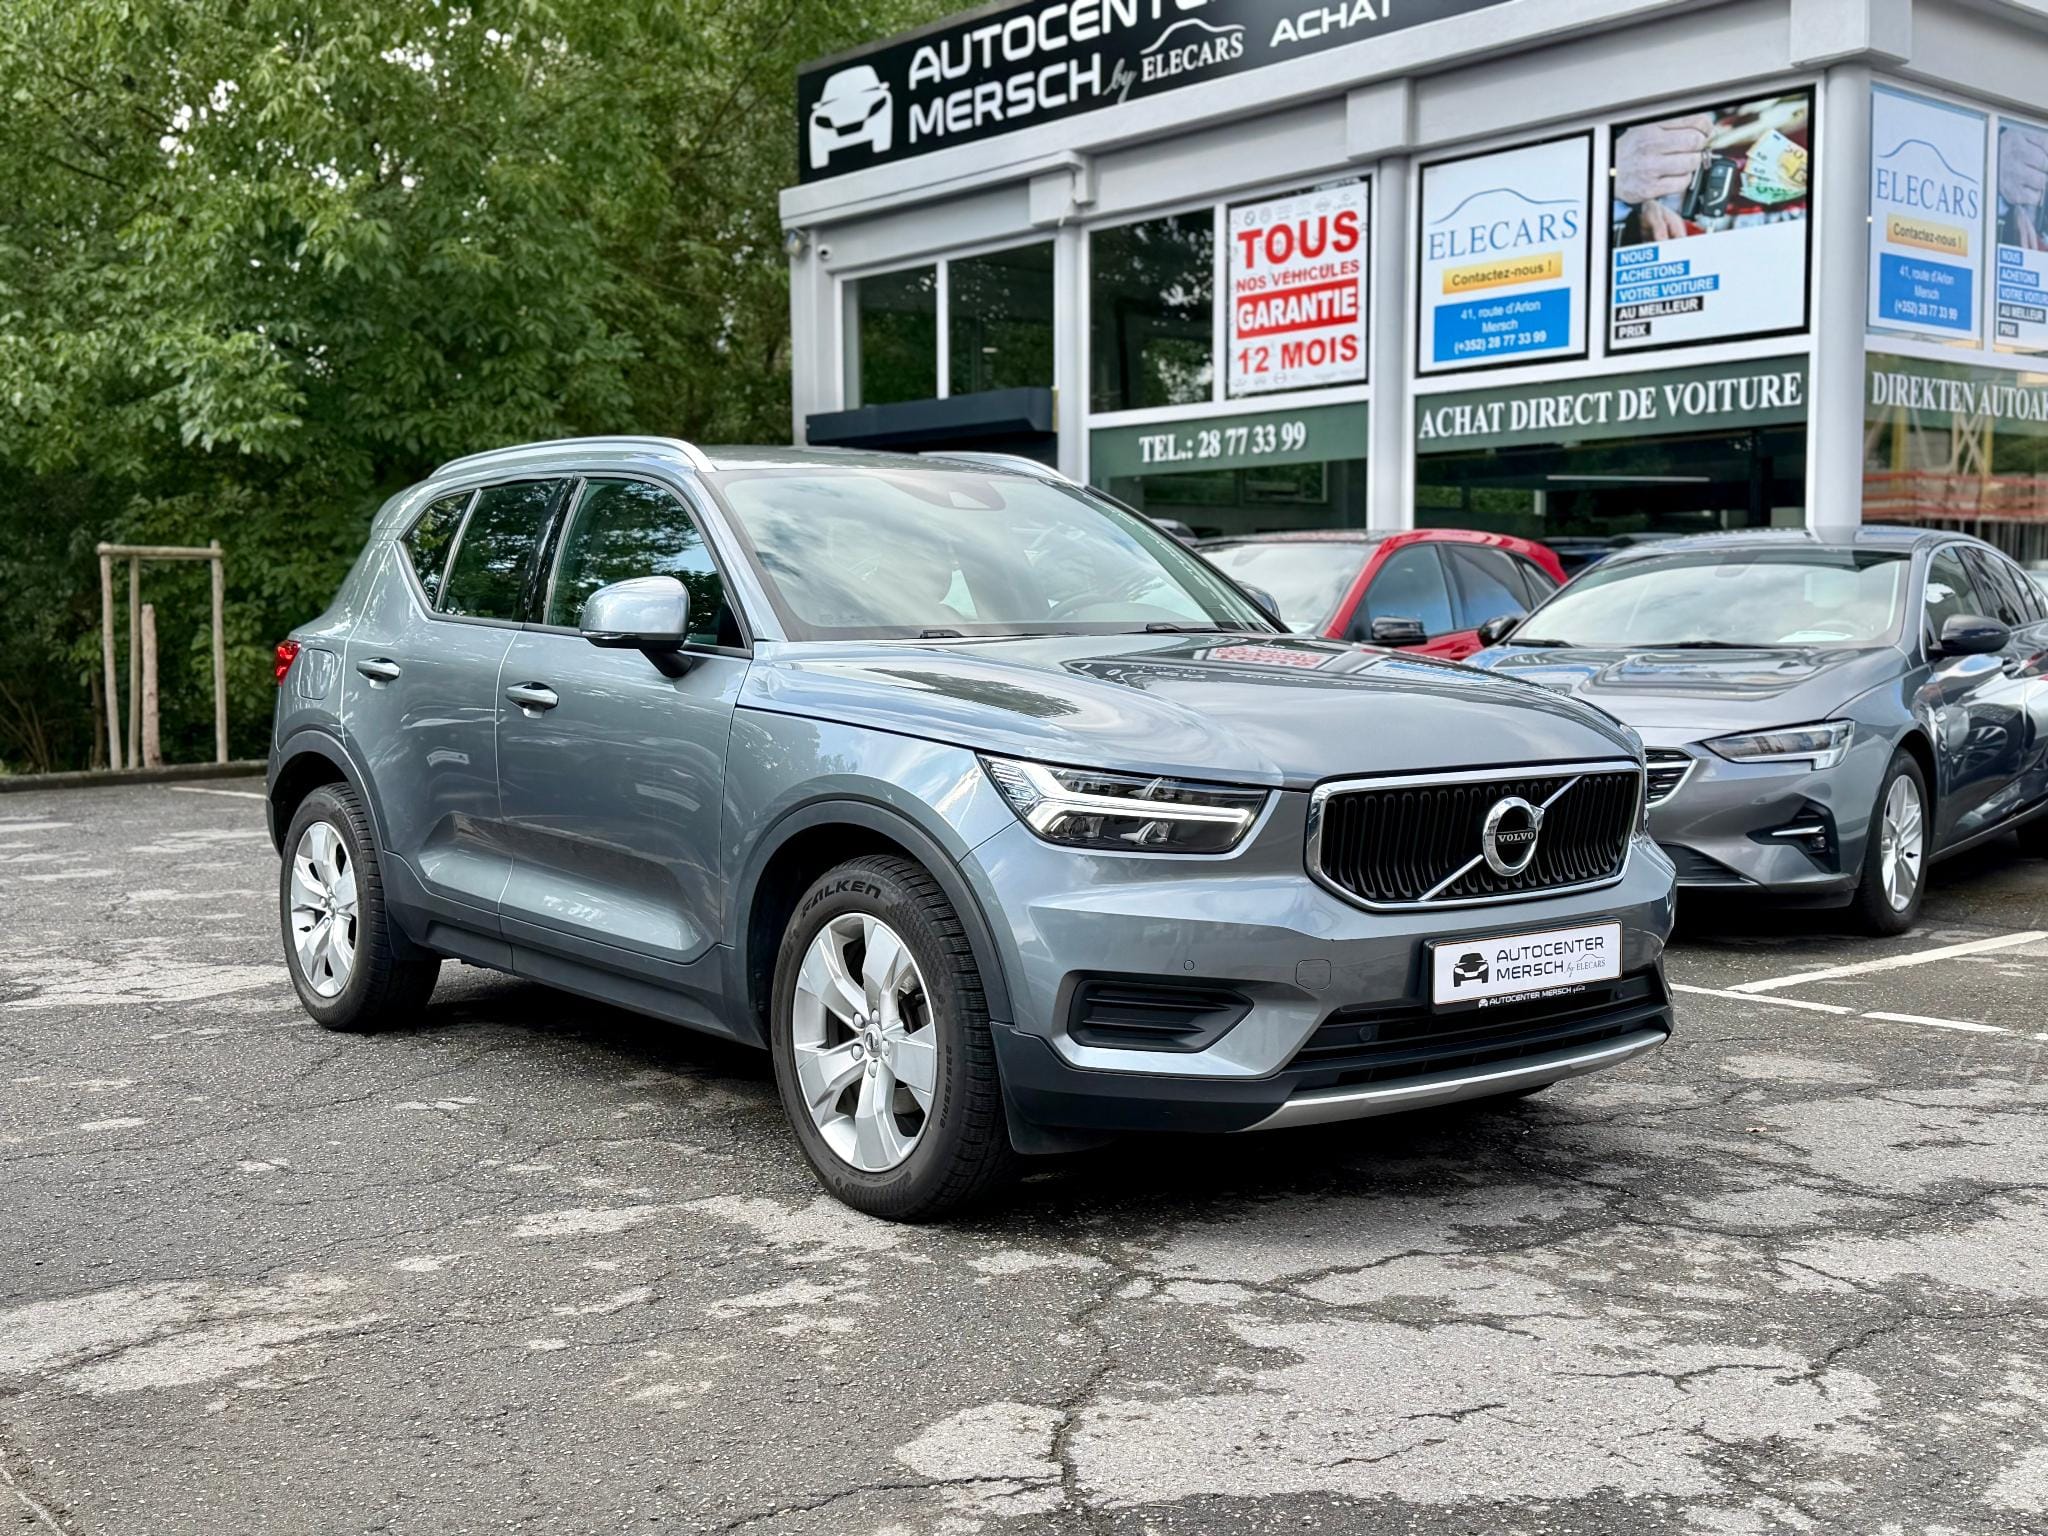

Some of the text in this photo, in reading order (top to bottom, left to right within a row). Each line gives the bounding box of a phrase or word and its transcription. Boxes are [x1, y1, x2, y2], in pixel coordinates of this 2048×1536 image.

[909, 0, 1216, 91] AUTOCEN
[908, 31, 1244, 144] MERSCH by ELECARS
[1876, 168, 1978, 219] ELECARS
[1237, 209, 1359, 270] TOUS
[1428, 209, 1579, 261] ELECARS
[1893, 222, 1957, 248] Contactez-nous
[1620, 249, 1654, 265] NOUS
[1236, 275, 1266, 293] NOS
[1451, 261, 1544, 287] Contactez-nous
[1620, 262, 1685, 283] ACHETONS
[1619, 277, 1714, 302] VOTRE VOITURE
[1238, 286, 1357, 331] GARANTIE
[1478, 304, 1504, 318] route
[1619, 299, 1698, 319] AU MEILLEUR
[1481, 318, 1519, 334] Mersch
[1619, 323, 1647, 338] PRIX
[1488, 335, 1500, 349] 28
[1503, 333, 1516, 347] 77
[1518, 332, 1531, 345] 33
[1533, 330, 1547, 344] 99
[1238, 333, 1359, 375] 12 MOIS
[1418, 372, 1802, 439] ACHAT DIRECT DE VOITURE
[1872, 371, 1976, 414] DIREKTEN
[1139, 421, 1306, 463] TEL.: 28 77 33 99
[1497, 831, 1534, 843] VOLVO
[801, 879, 882, 919] FALKEN
[1496, 936, 1604, 963] AUTOCENTER
[1496, 959, 1606, 982] MERSCH by ELECARS
[1490, 991, 1540, 1005] AUTOCENTER
[1541, 987, 1571, 998] MERSCH
